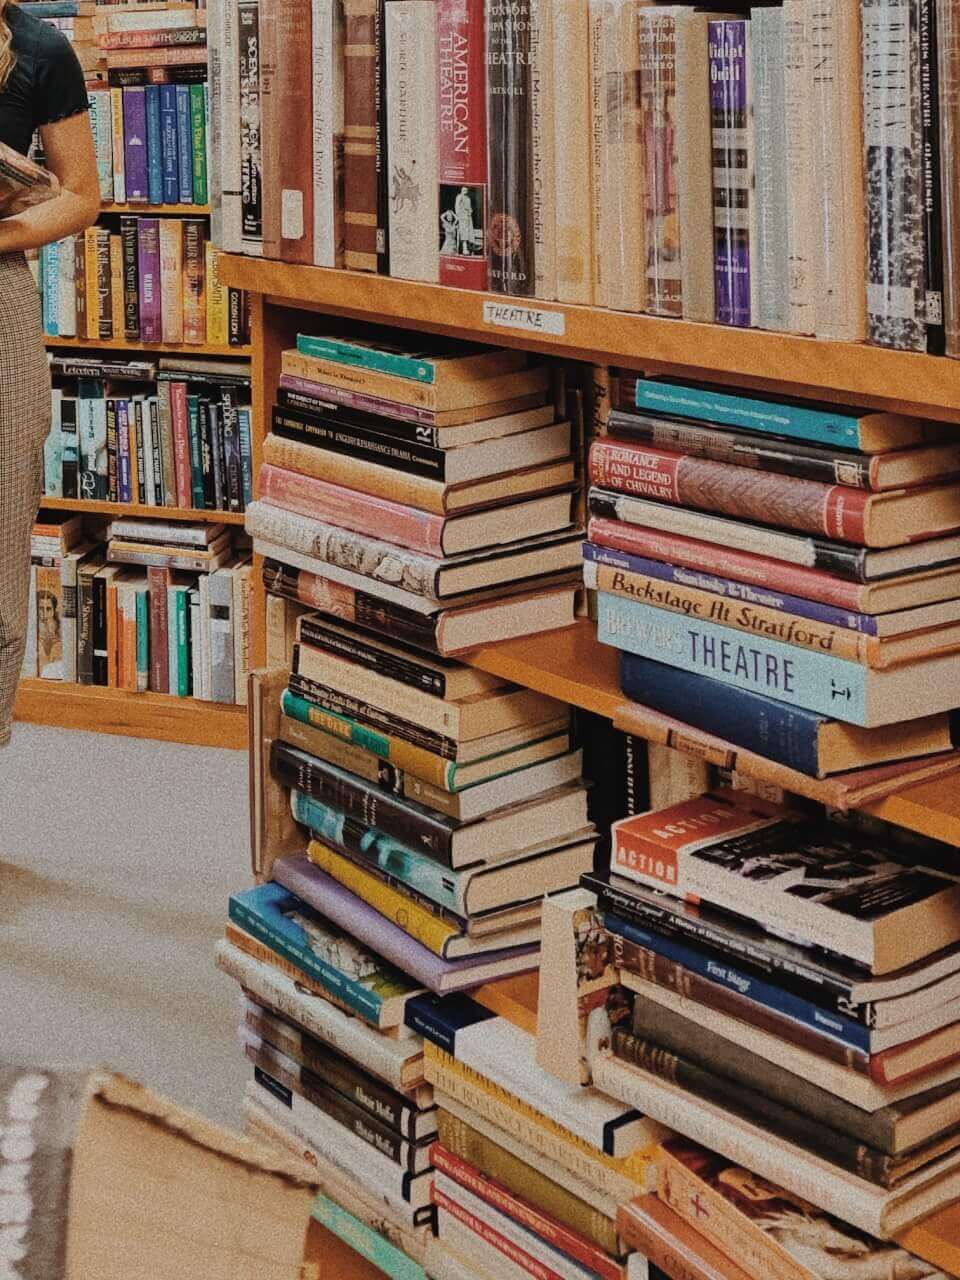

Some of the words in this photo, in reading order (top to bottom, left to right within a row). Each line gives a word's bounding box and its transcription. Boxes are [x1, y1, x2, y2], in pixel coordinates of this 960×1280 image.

[440, 33, 454, 133] THEATRE
[453, 32, 469, 154] AMERICAN
[486, 306, 543, 327] THEATRE
[611, 464, 632, 477] AND
[633, 468, 672, 485] LEGEND
[612, 451, 659, 468] ROMANCE
[611, 477, 624, 489] OF
[626, 481, 673, 498] CHIVALRY
[612, 572, 703, 615] Backstage
[735, 606, 835, 651] Stratford
[688, 630, 795, 694] THEATRE
[651, 807, 736, 840] ACTION
[617, 847, 676, 883] ACTION
